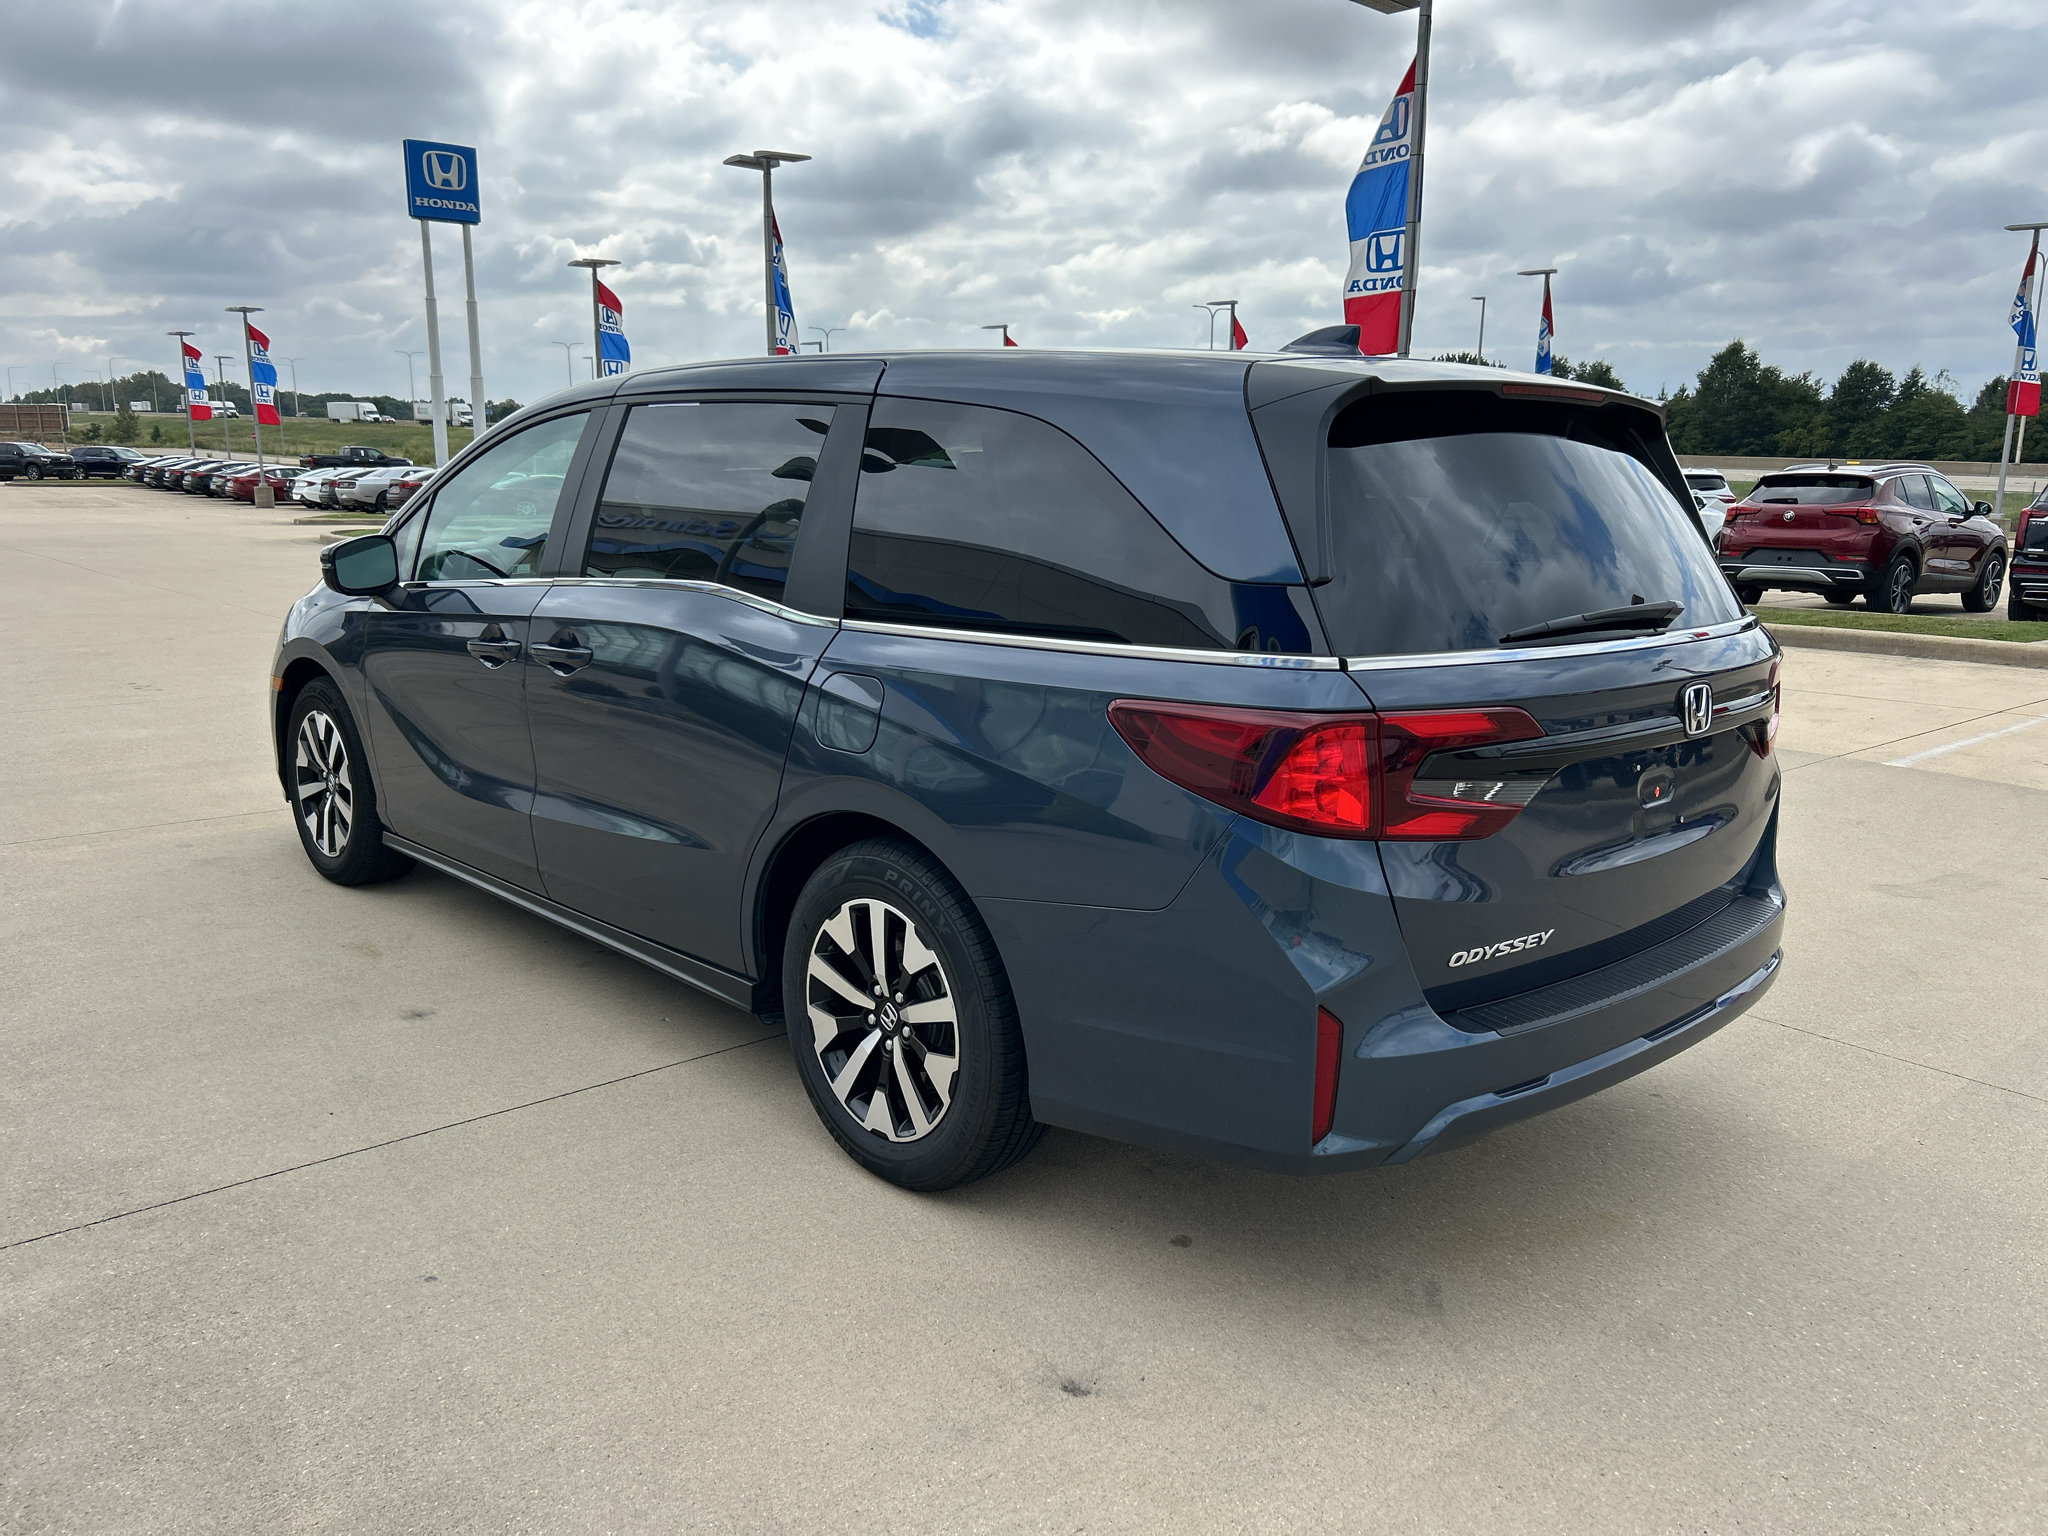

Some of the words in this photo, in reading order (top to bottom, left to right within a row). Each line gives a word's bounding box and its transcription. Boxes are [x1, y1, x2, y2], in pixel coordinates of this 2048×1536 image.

[415, 196, 478, 212] HONDA
[884, 869, 952, 935] PRINX
[1448, 928, 1555, 968] ODYSSEY
